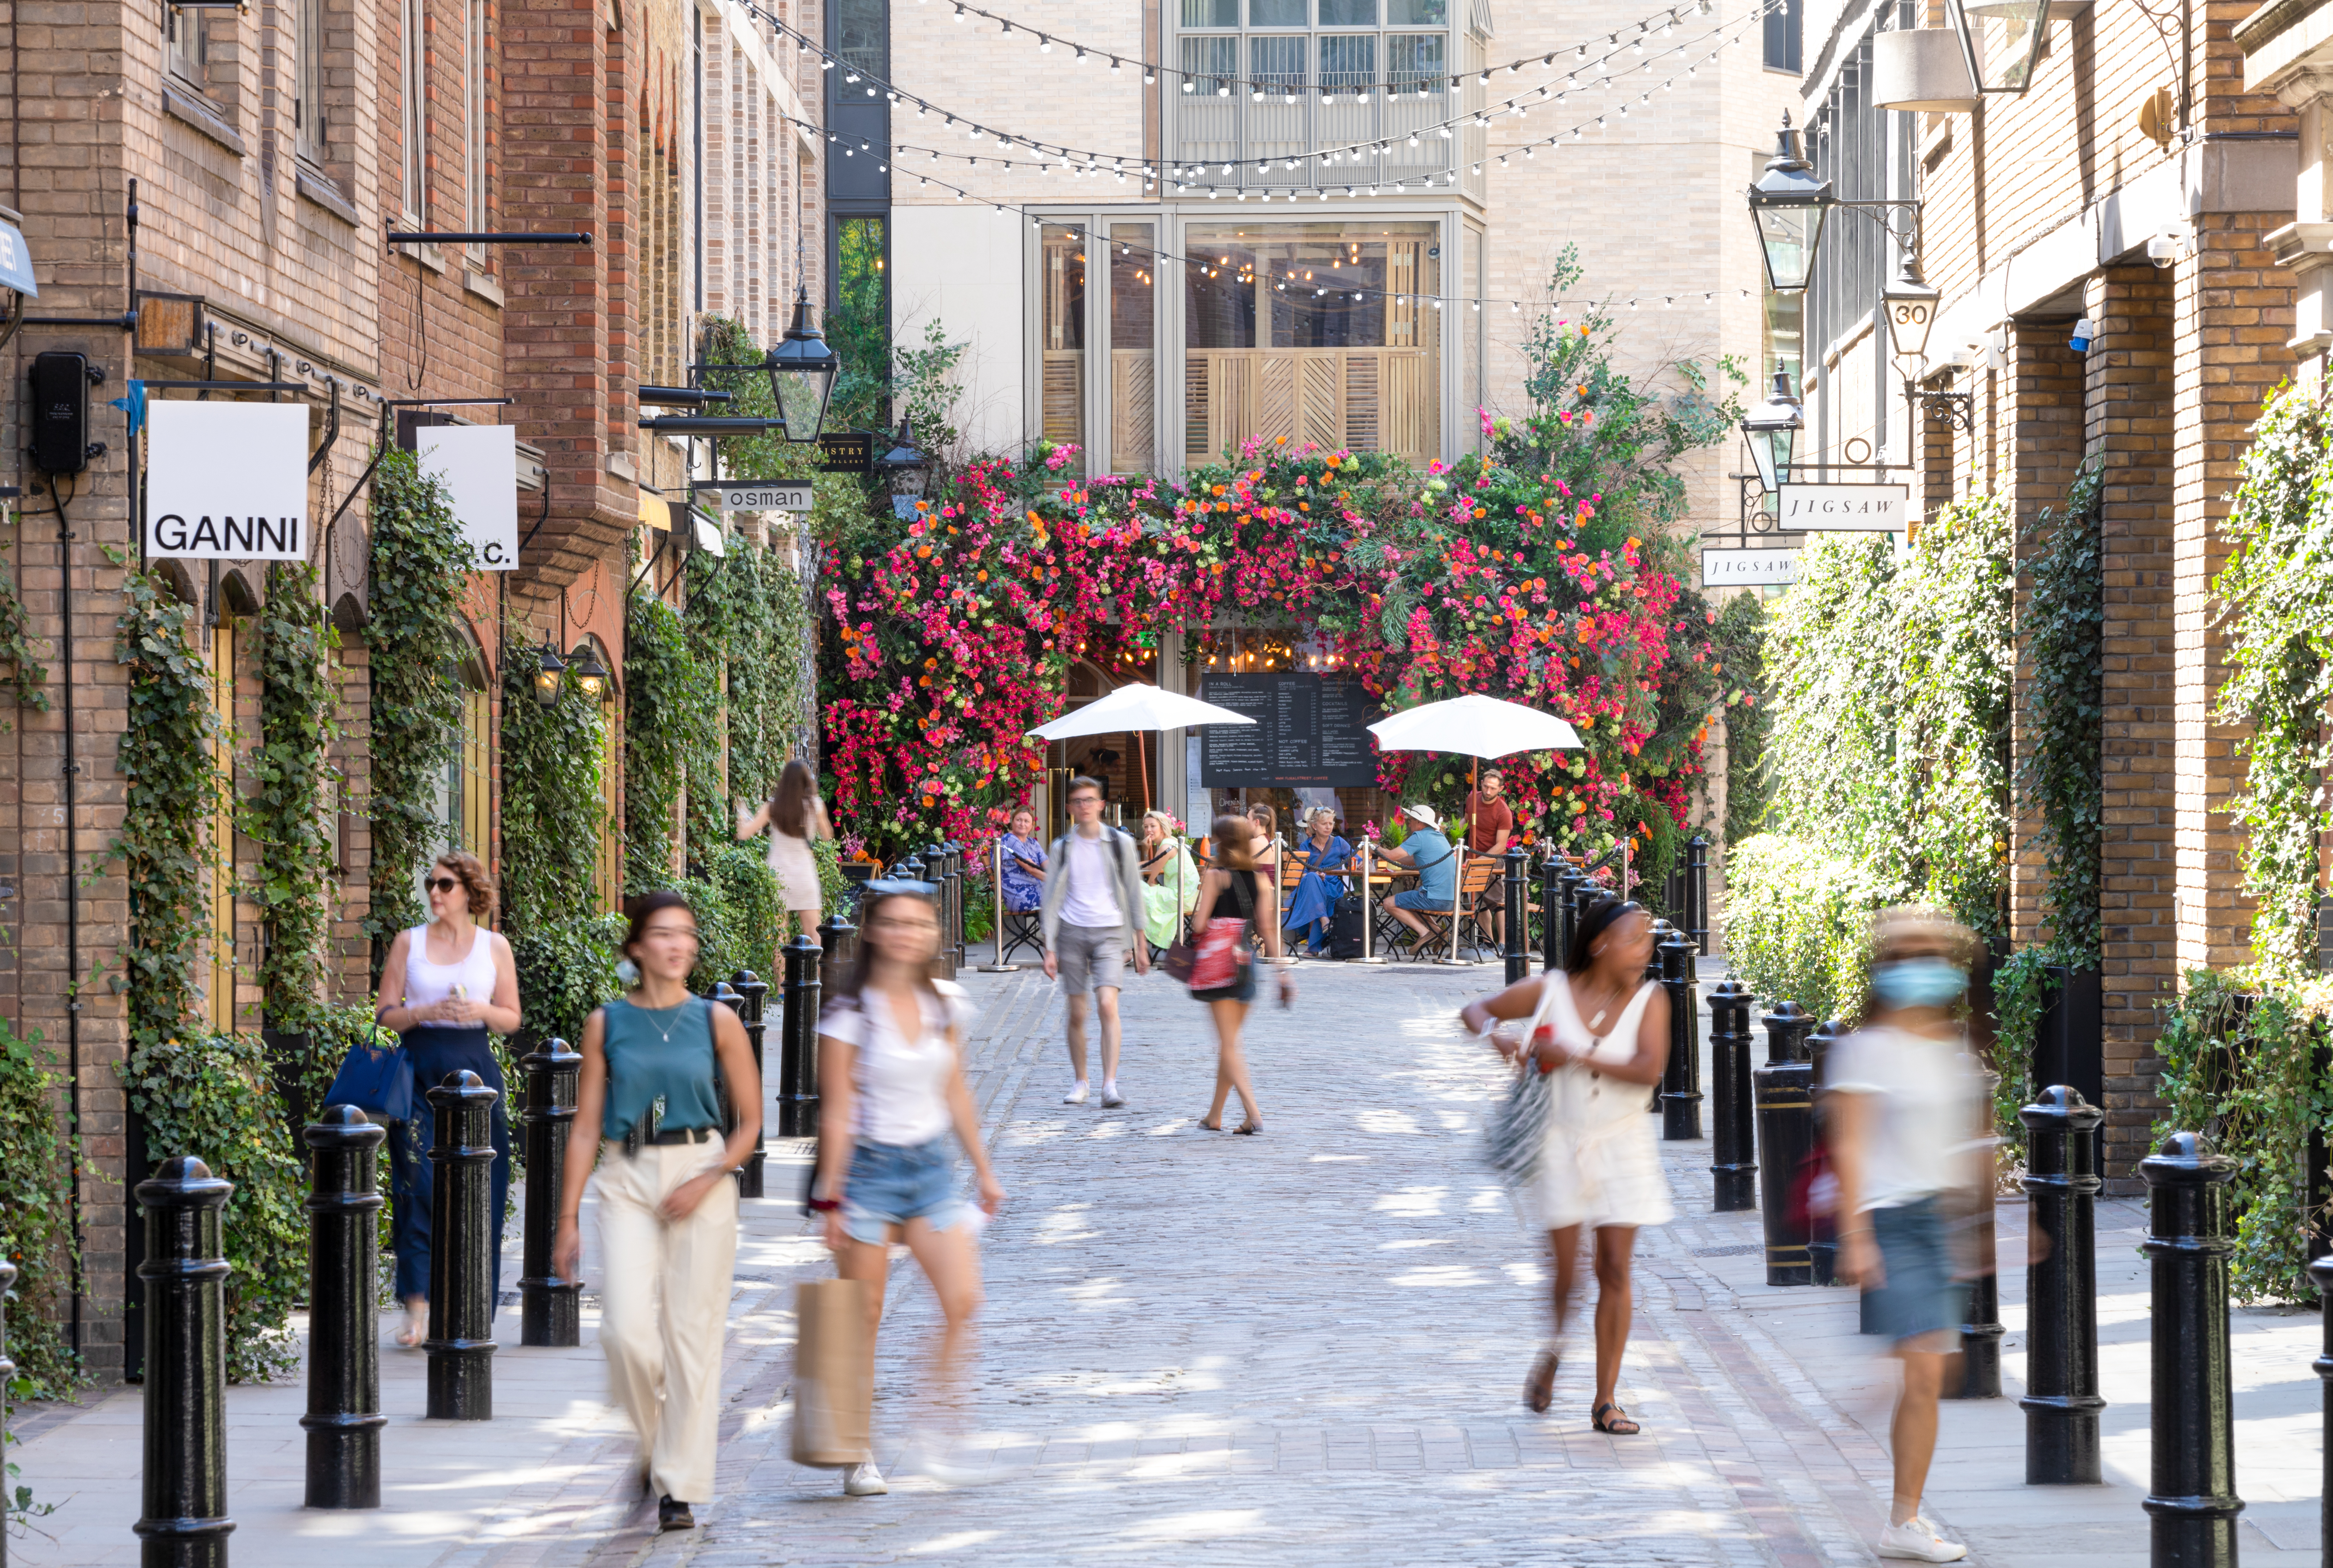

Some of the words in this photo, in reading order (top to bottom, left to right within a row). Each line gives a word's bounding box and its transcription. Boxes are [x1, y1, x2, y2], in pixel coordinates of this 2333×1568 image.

[1895, 305, 1927, 324] 30
[730, 492, 802, 505] osman
[1788, 500, 1893, 516] JIGSAW
[155, 515, 297, 552] GANNI
[1710, 561, 1792, 575] JIGSAW
[53, 808, 64, 824] 5
